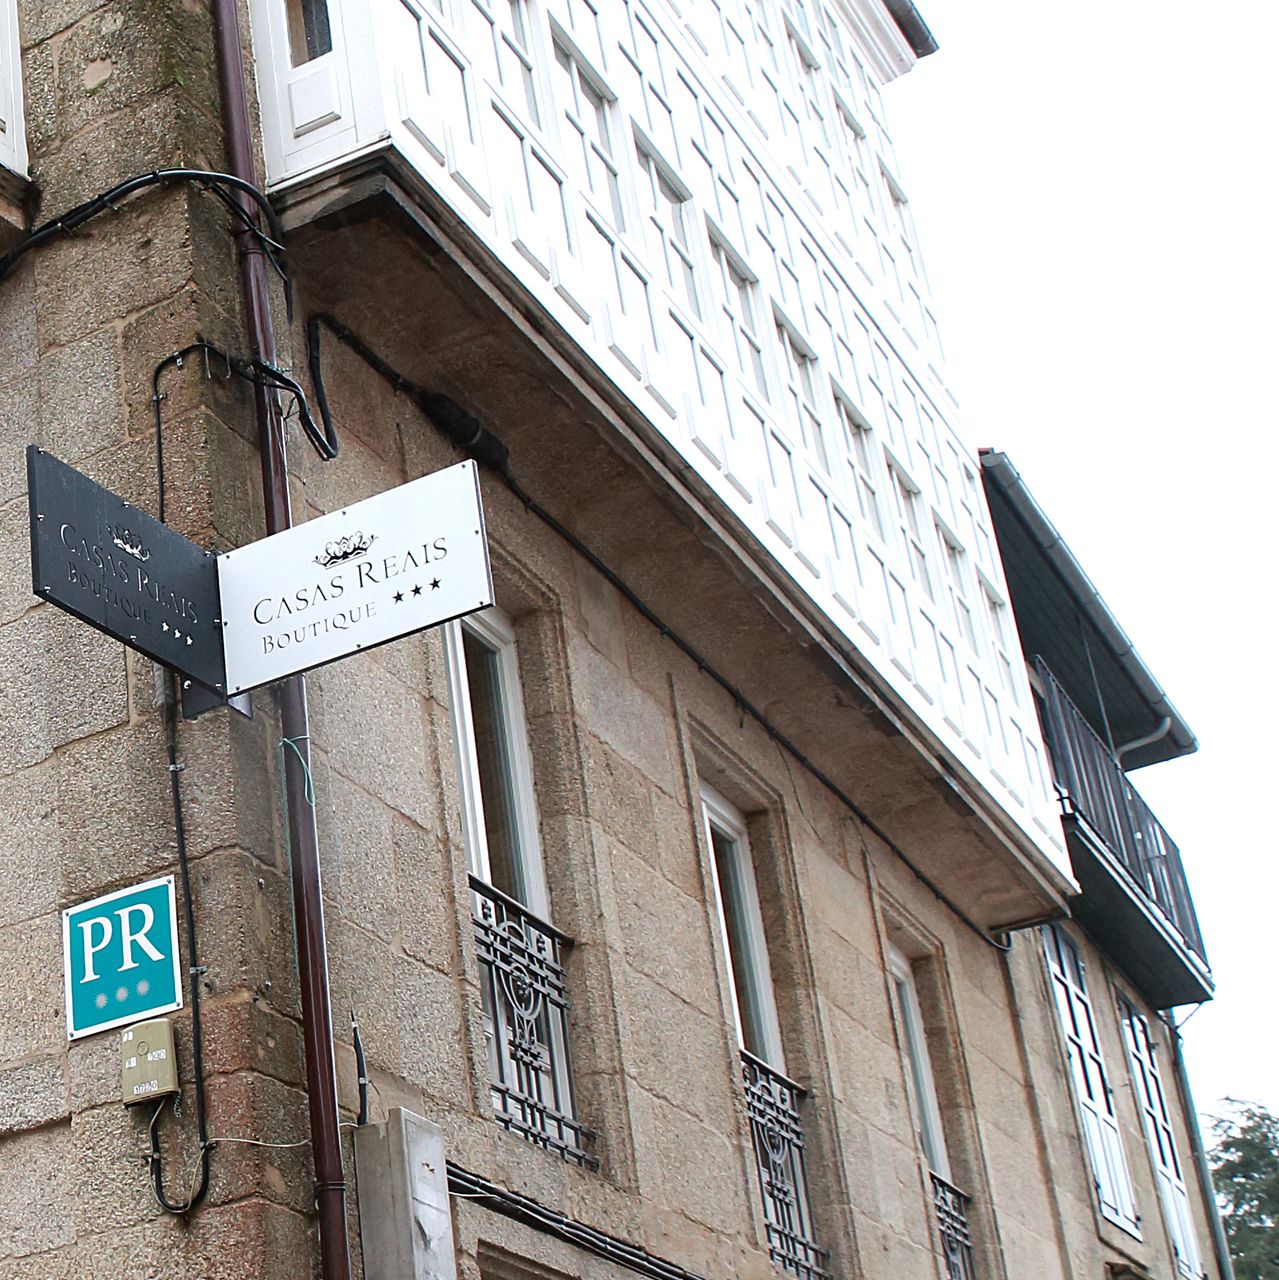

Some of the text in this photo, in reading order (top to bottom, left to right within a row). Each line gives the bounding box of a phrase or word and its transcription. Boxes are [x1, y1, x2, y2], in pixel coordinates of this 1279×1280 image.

[60, 523, 198, 623] CASAS REAIS
[66, 561, 151, 625] BOUTIQUE
[253, 537, 448, 625] CASAS REAIS
[262, 601, 377, 655] BOUTIQUE
[77, 903, 165, 984] PR
